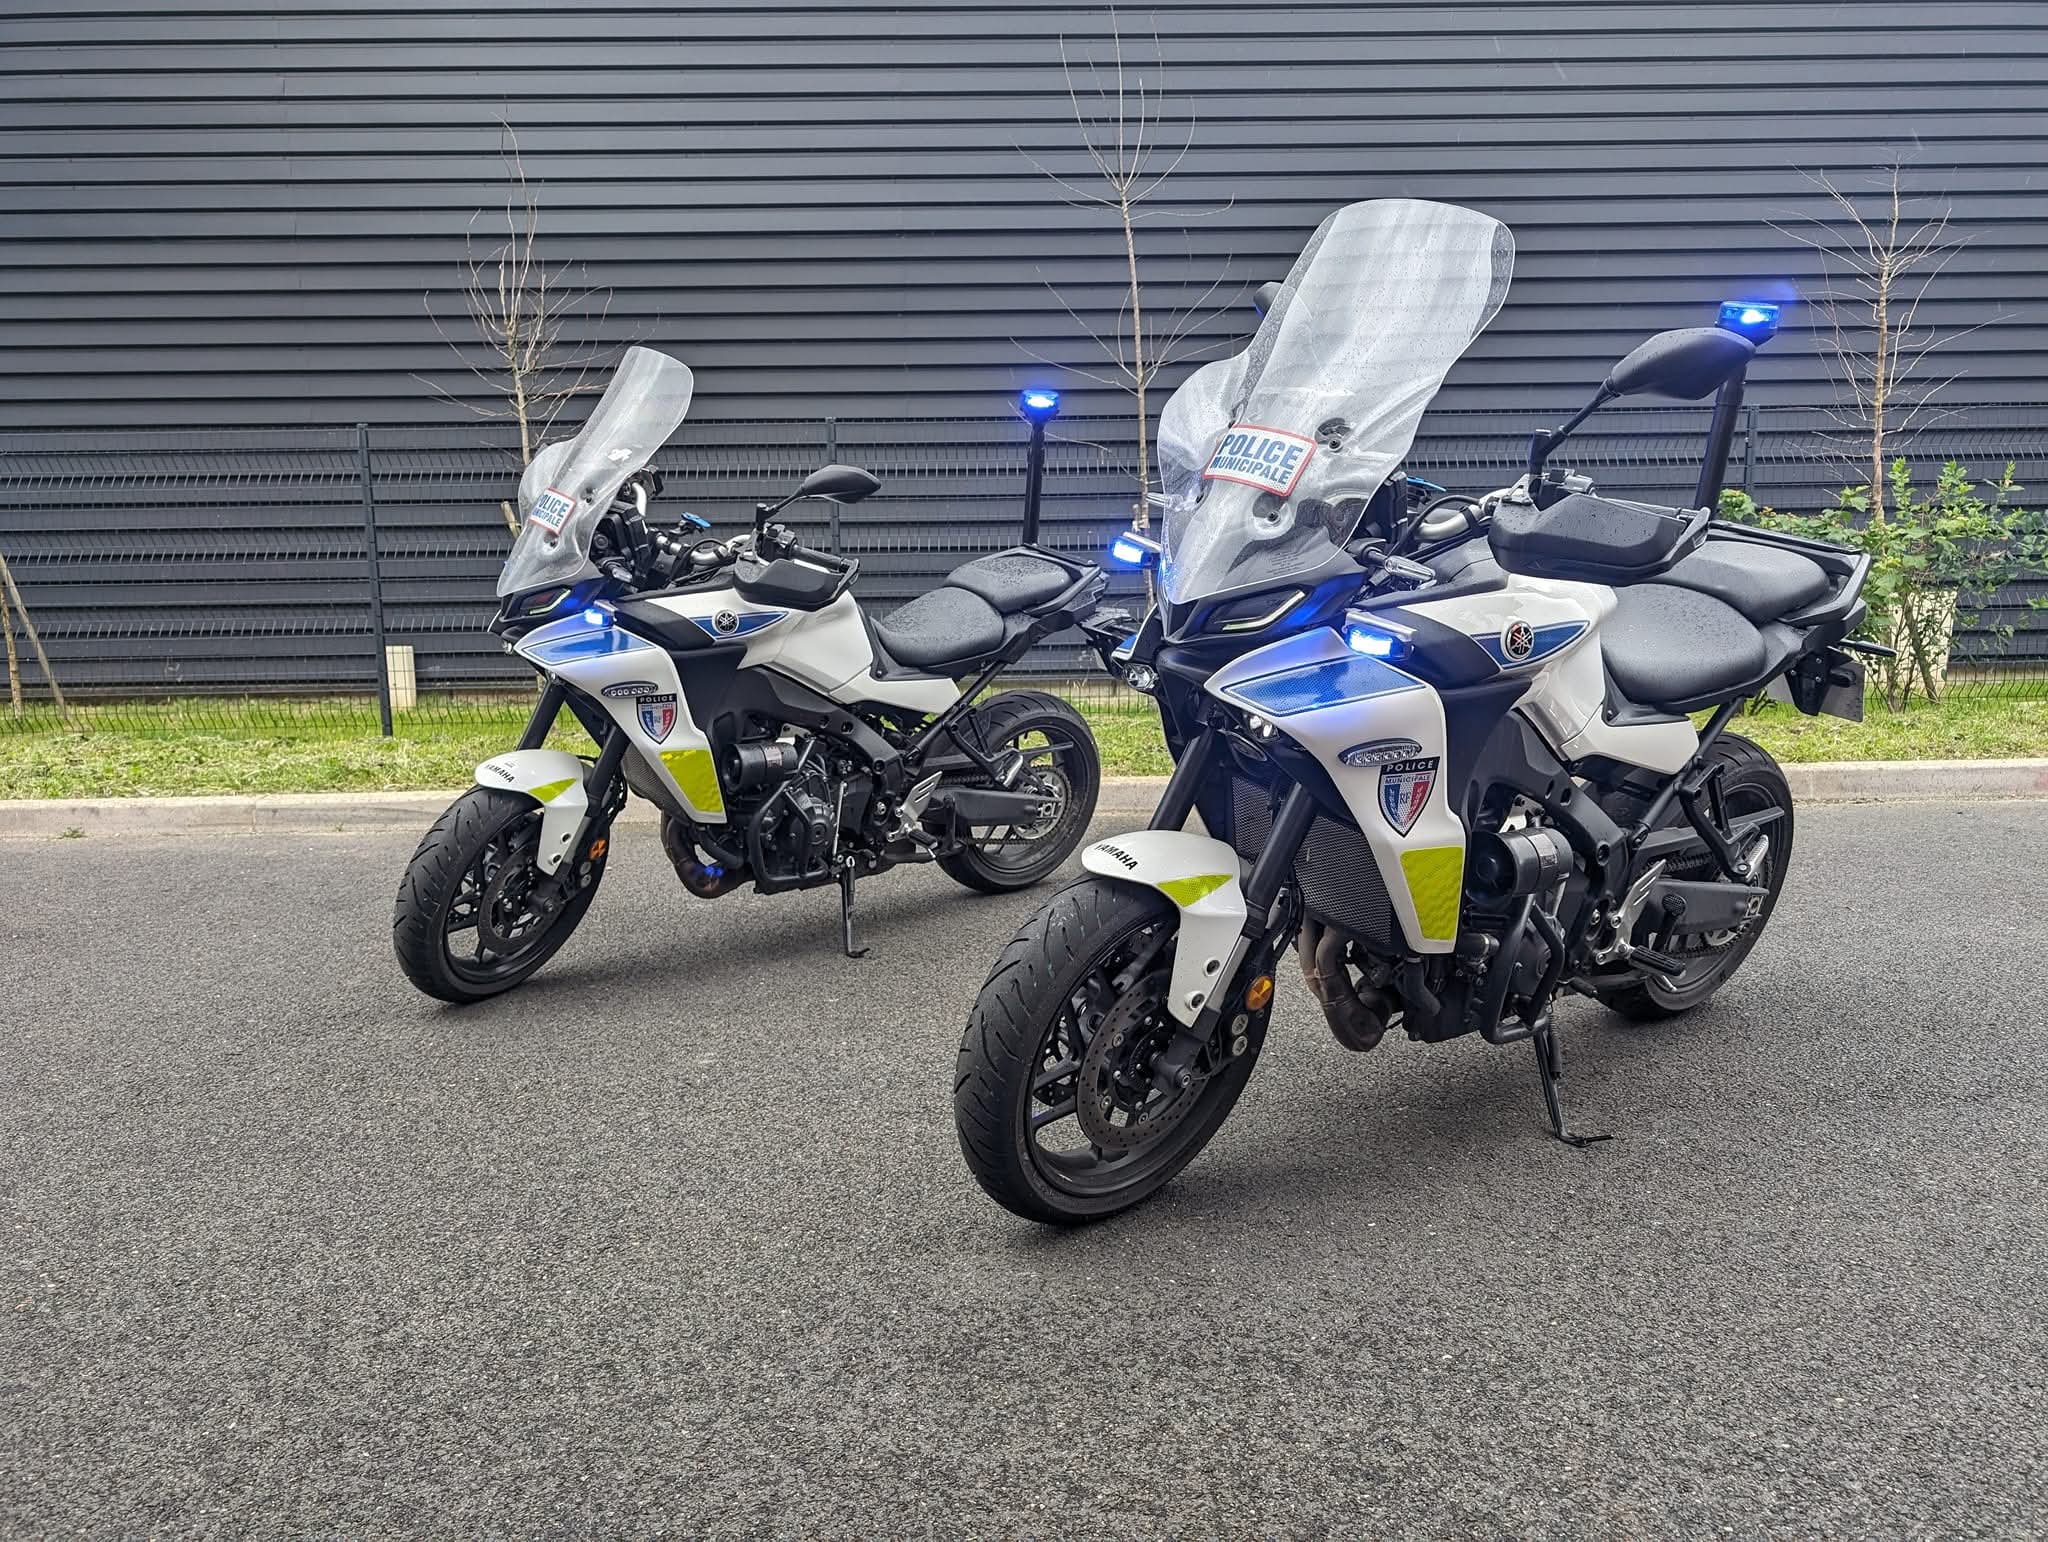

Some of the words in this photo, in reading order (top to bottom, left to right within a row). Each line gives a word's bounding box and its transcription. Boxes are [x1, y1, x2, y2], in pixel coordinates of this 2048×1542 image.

[1217, 432, 1304, 470] POLICE
[1210, 455, 1292, 485] MUNICIPALE
[640, 695, 673, 703] POLICE
[1386, 760, 1433, 772] POLICE
[1095, 844, 1138, 870] YAMAHA
